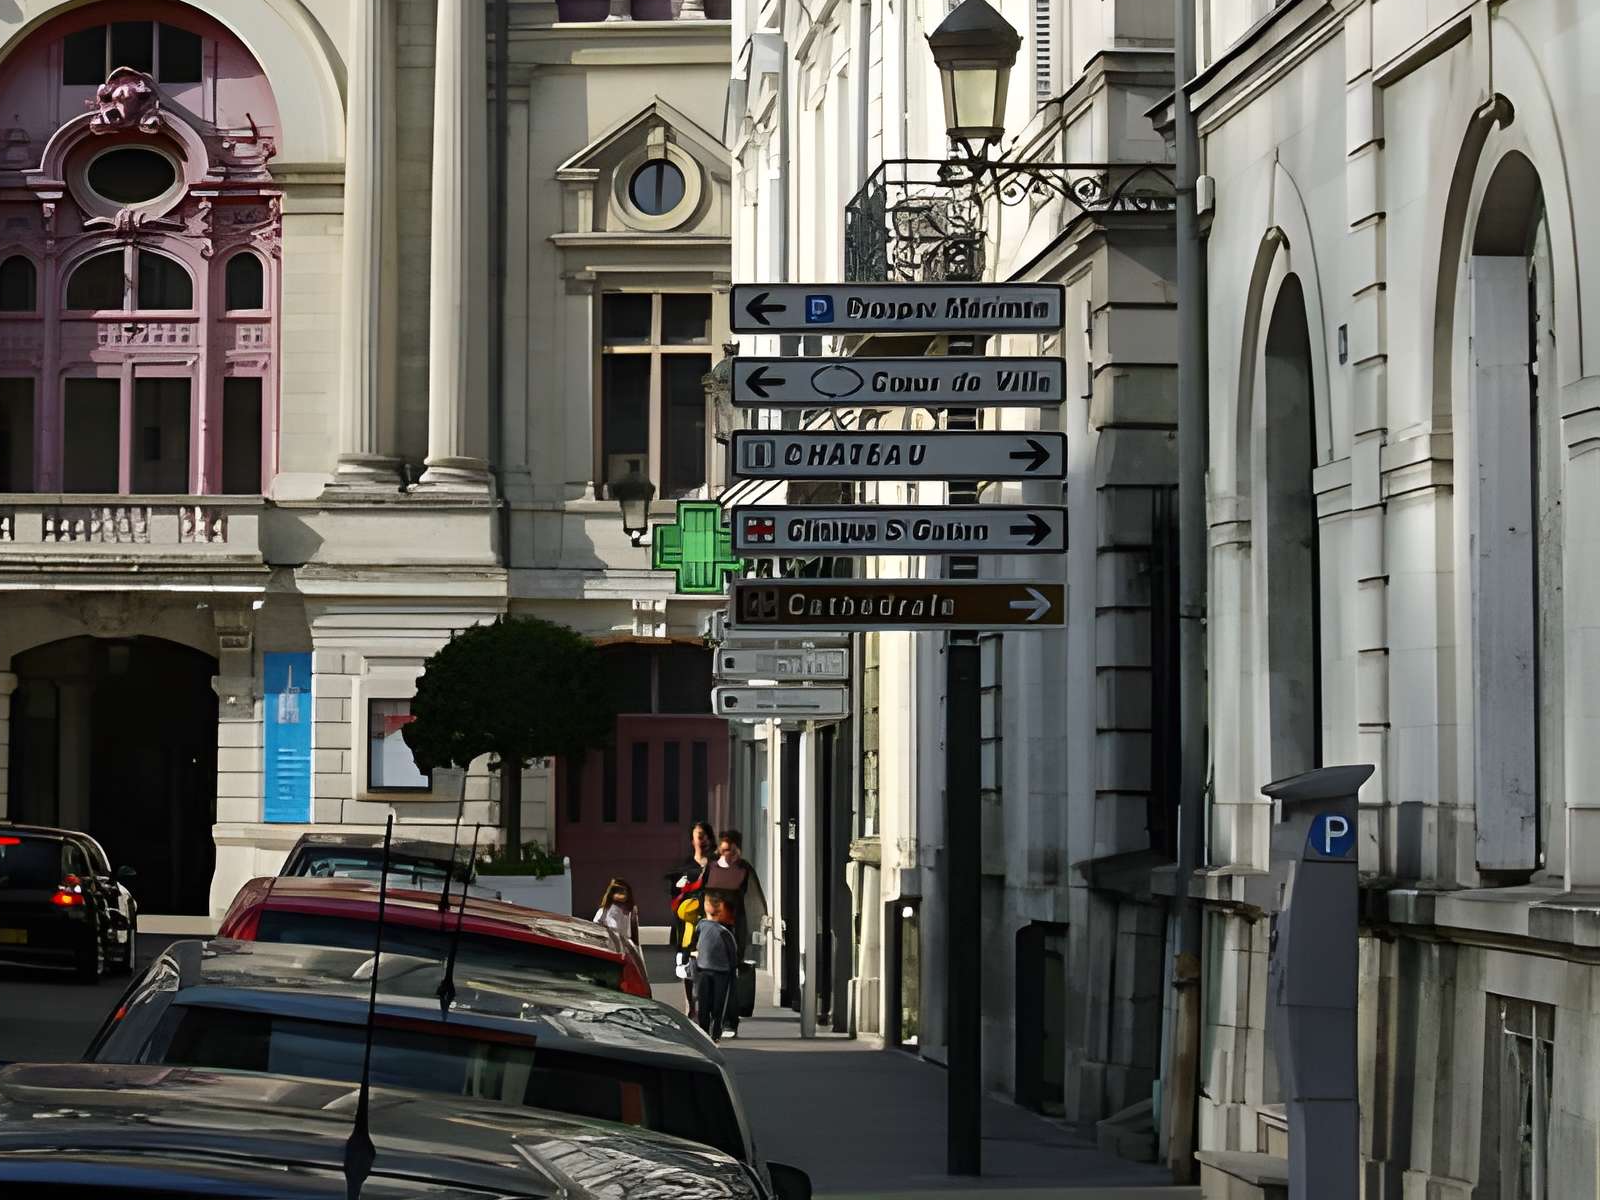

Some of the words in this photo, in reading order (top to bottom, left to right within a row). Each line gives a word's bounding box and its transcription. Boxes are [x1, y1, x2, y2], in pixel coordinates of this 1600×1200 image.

[952, 371, 981, 392] de
[997, 371, 1050, 392] Ville
[1325, 815, 1349, 853] P
